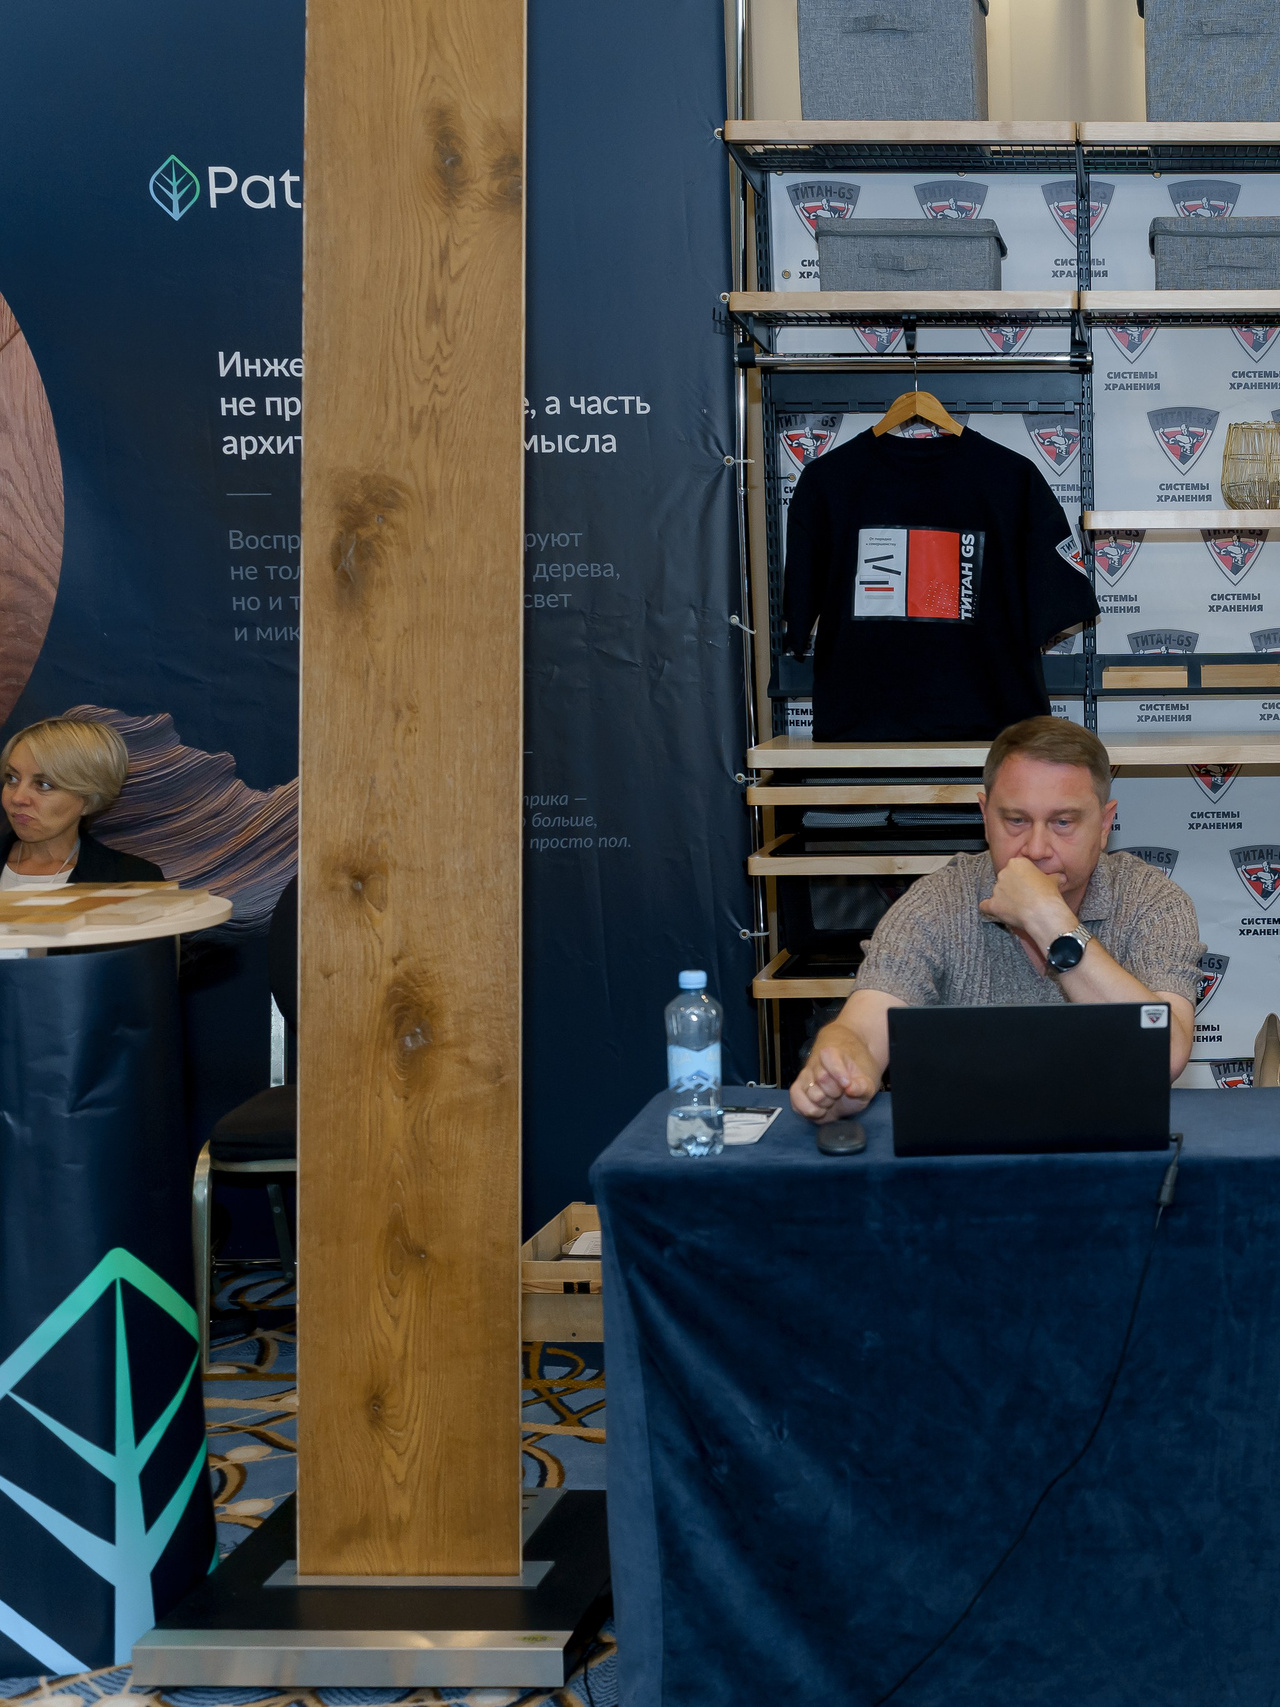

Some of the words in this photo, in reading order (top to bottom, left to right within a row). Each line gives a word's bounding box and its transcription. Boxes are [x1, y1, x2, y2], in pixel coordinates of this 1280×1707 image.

[792, 185, 854, 201] ТИТАН-GS
[1106, 371, 1158, 380] СИСТЕМЫ
[1104, 382, 1160, 391] СИСТЕМЫ
[220, 397, 256, 416] не
[545, 396, 561, 415] а
[569, 395, 651, 415] часть
[1159, 483, 1210, 491] СИСТЕМЫ
[1156, 494, 1212, 502] СИСТЕМЫ
[960, 533, 975, 558] GS
[230, 565, 258, 580] не
[532, 562, 621, 582] дерева,
[960, 562, 974, 620] ТИТАН
[1210, 593, 1261, 601] СИСТЕМЫ
[232, 596, 261, 611] но
[269, 596, 282, 610] и
[1099, 605, 1140, 613] АНЕНИЯ
[1208, 604, 1263, 613] СИСТЕМЫ
[234, 627, 248, 641] и
[1133, 634, 1192, 648] ТИТАН-GS
[1139, 703, 1189, 711] СИСТЕМЫ
[1136, 714, 1192, 722] СИСТЕМЫ
[532, 812, 598, 829] больше,
[1190, 811, 1240, 819] СИСТЕМЫ
[1188, 822, 1242, 830] СИСТЕМЫ
[530, 837, 593, 851] просто
[598, 836, 631, 848] пол.
[1215, 1062, 1254, 1076] ТИТАН
